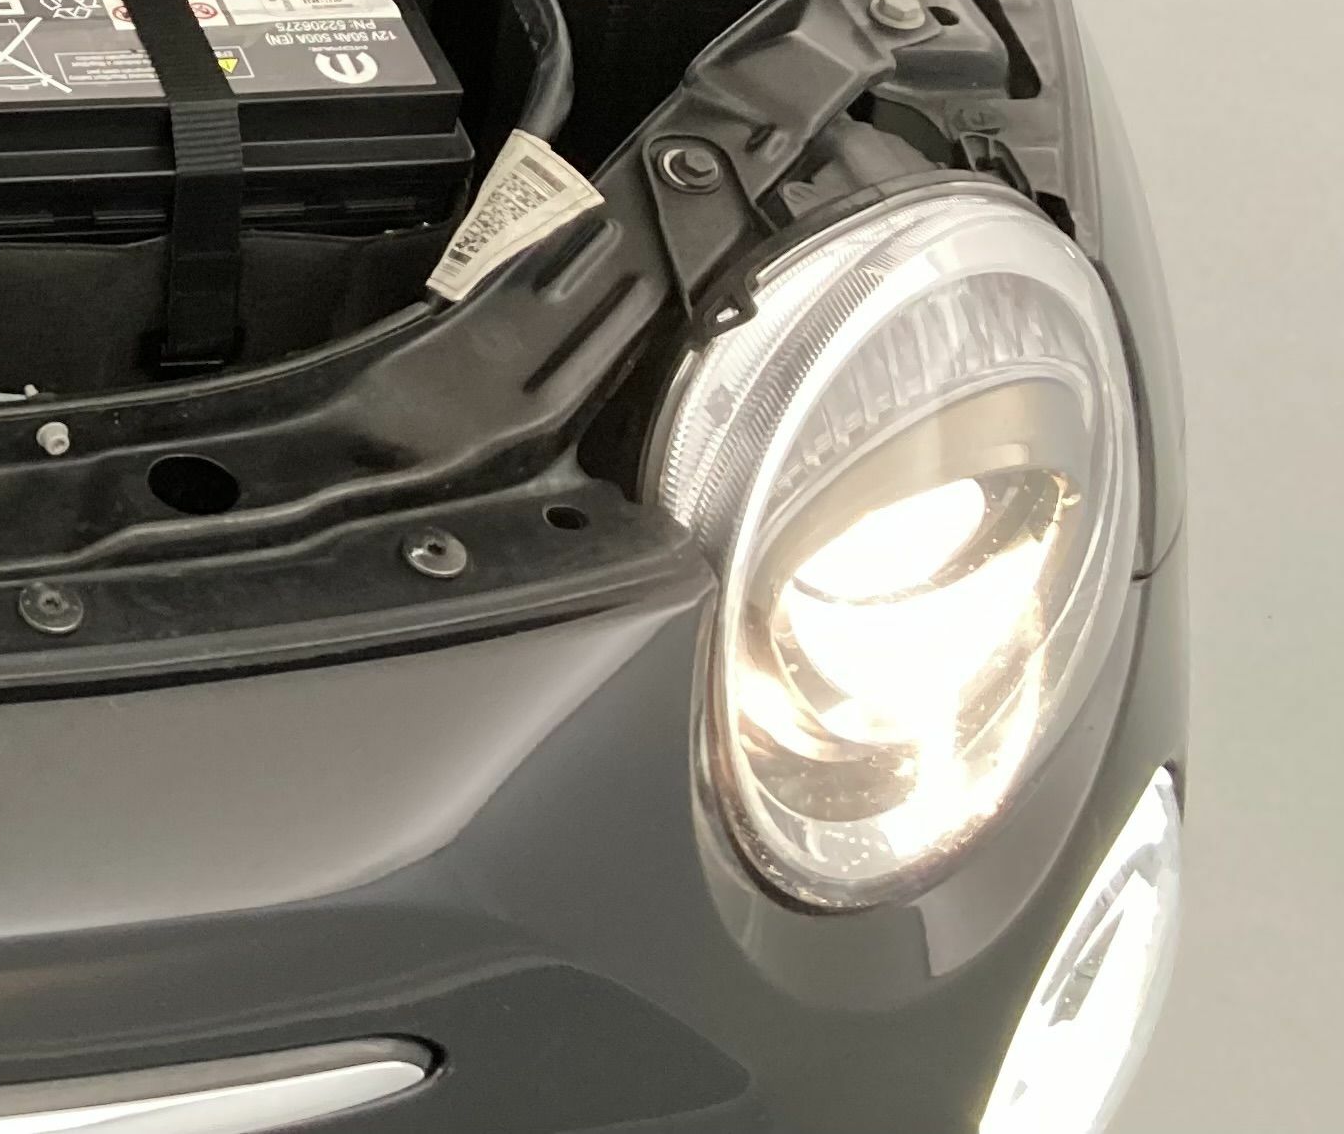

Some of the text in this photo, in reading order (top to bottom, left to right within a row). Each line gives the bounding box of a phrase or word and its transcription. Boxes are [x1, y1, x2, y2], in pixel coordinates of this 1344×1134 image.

[275, 19, 347, 32] 52206275
[264, 32, 294, 46] (EN)
[295, 32, 332, 44] 500A
[371, 29, 397, 41] 12V
